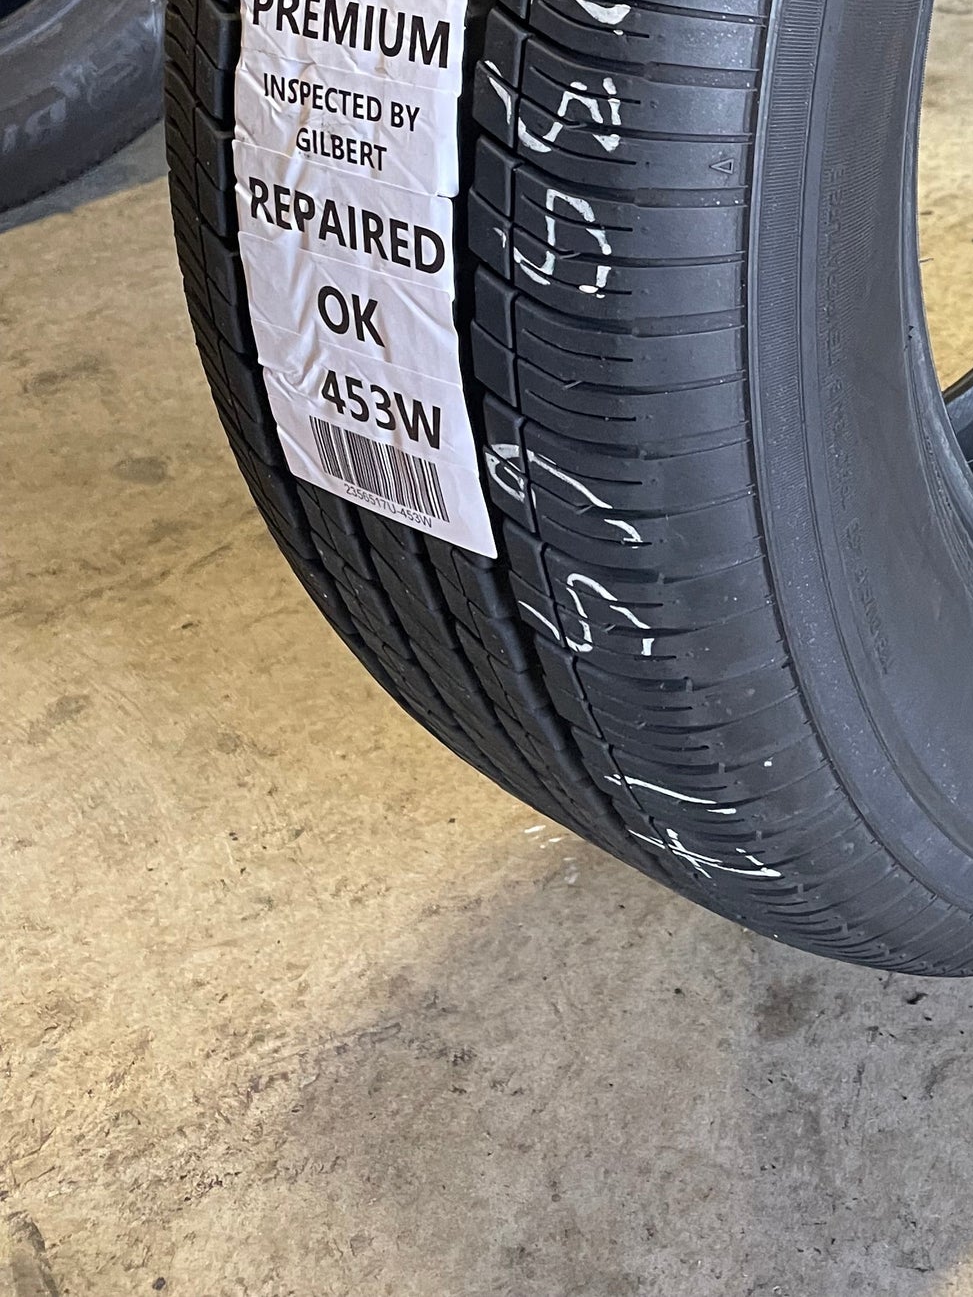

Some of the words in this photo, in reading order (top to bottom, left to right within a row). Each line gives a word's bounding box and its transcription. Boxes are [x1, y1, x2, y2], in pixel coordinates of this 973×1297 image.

[264, 73, 382, 122] INSPECTED
[391, 101, 420, 132] BY
[296, 128, 387, 171] GILBERT
[249, 177, 445, 274] REPAIRED
[318, 285, 385, 348] OK
[321, 370, 441, 450] 453W
[344, 483, 432, 528] 2356517U-453W
